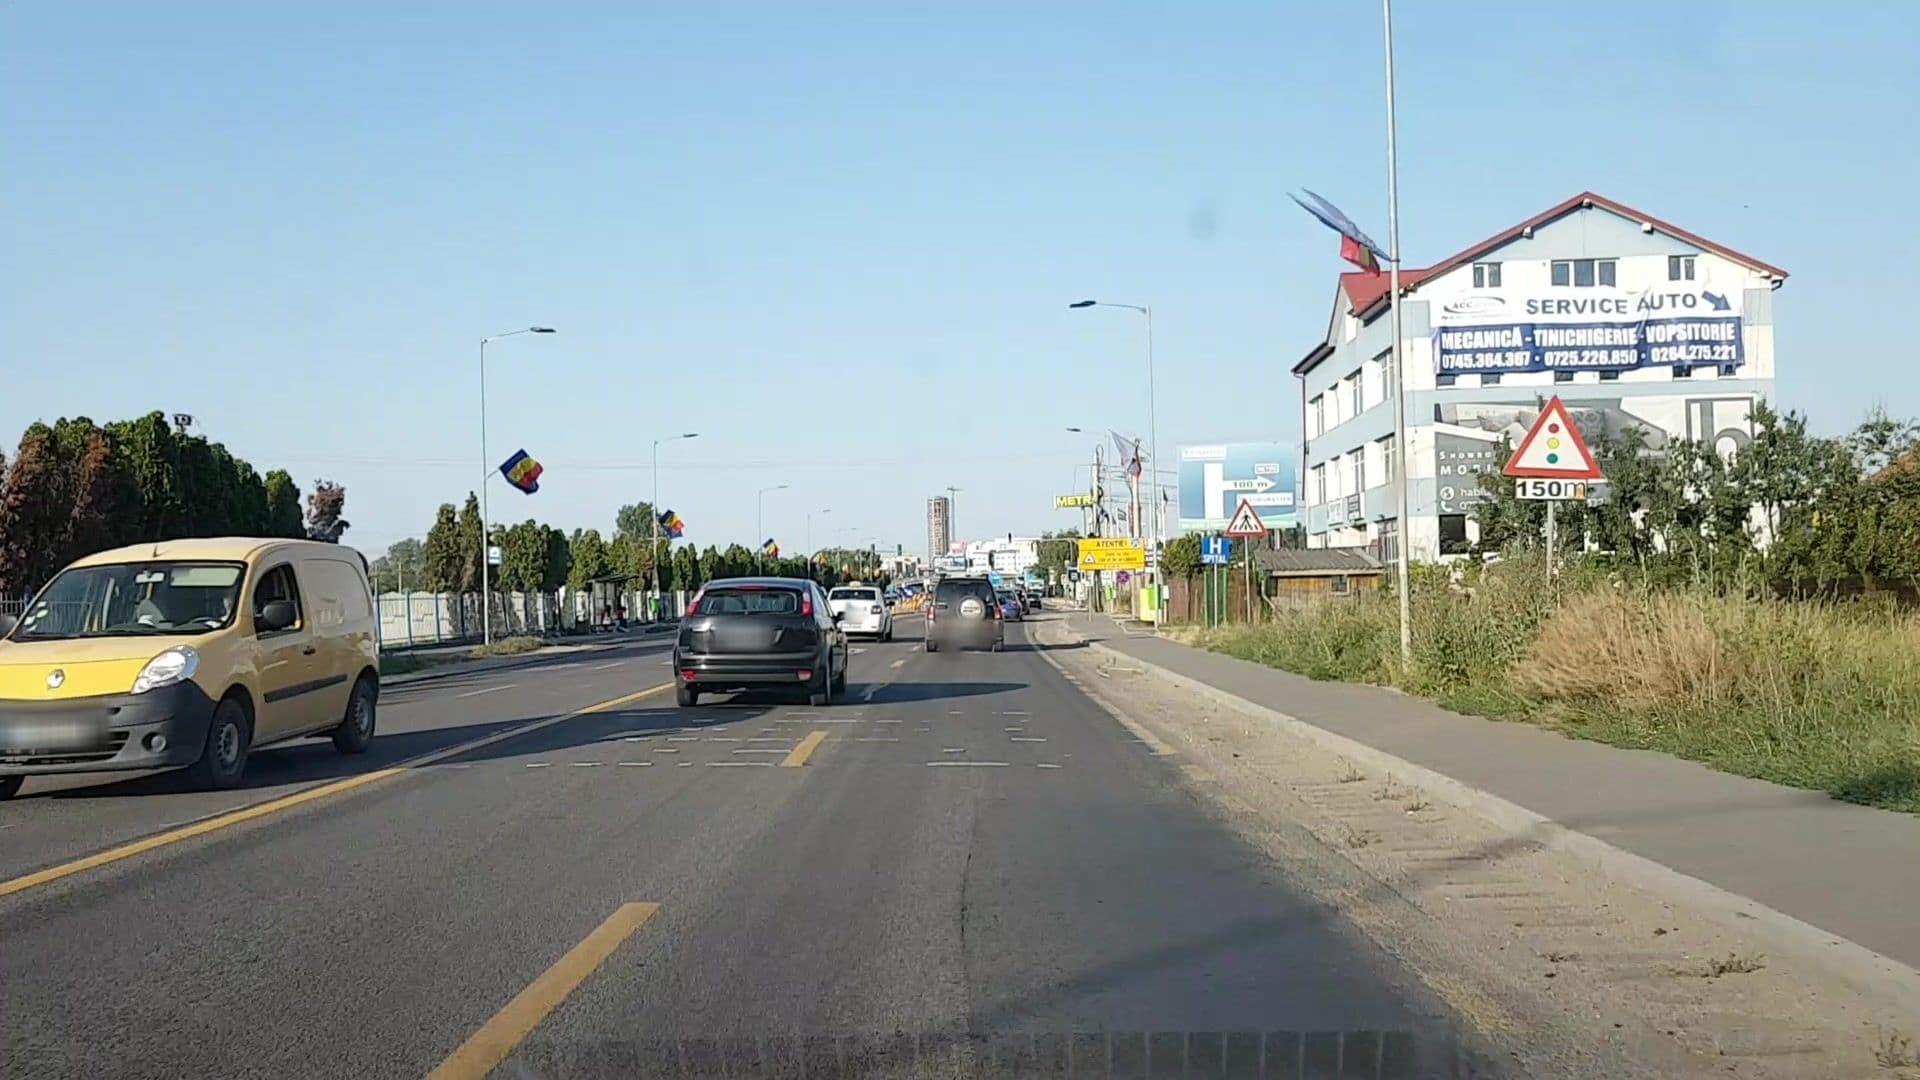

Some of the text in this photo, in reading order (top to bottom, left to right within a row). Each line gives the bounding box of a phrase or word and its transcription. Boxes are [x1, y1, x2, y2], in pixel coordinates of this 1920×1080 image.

[1526, 293, 1697, 315] SERVICE AUTO
[1533, 328, 1638, 347] TINICHIGERIE
[1645, 323, 1736, 343] VOPSITORIE
[1544, 349, 1638, 366] 0725.226.850
[1516, 481, 1586, 497] 150m
